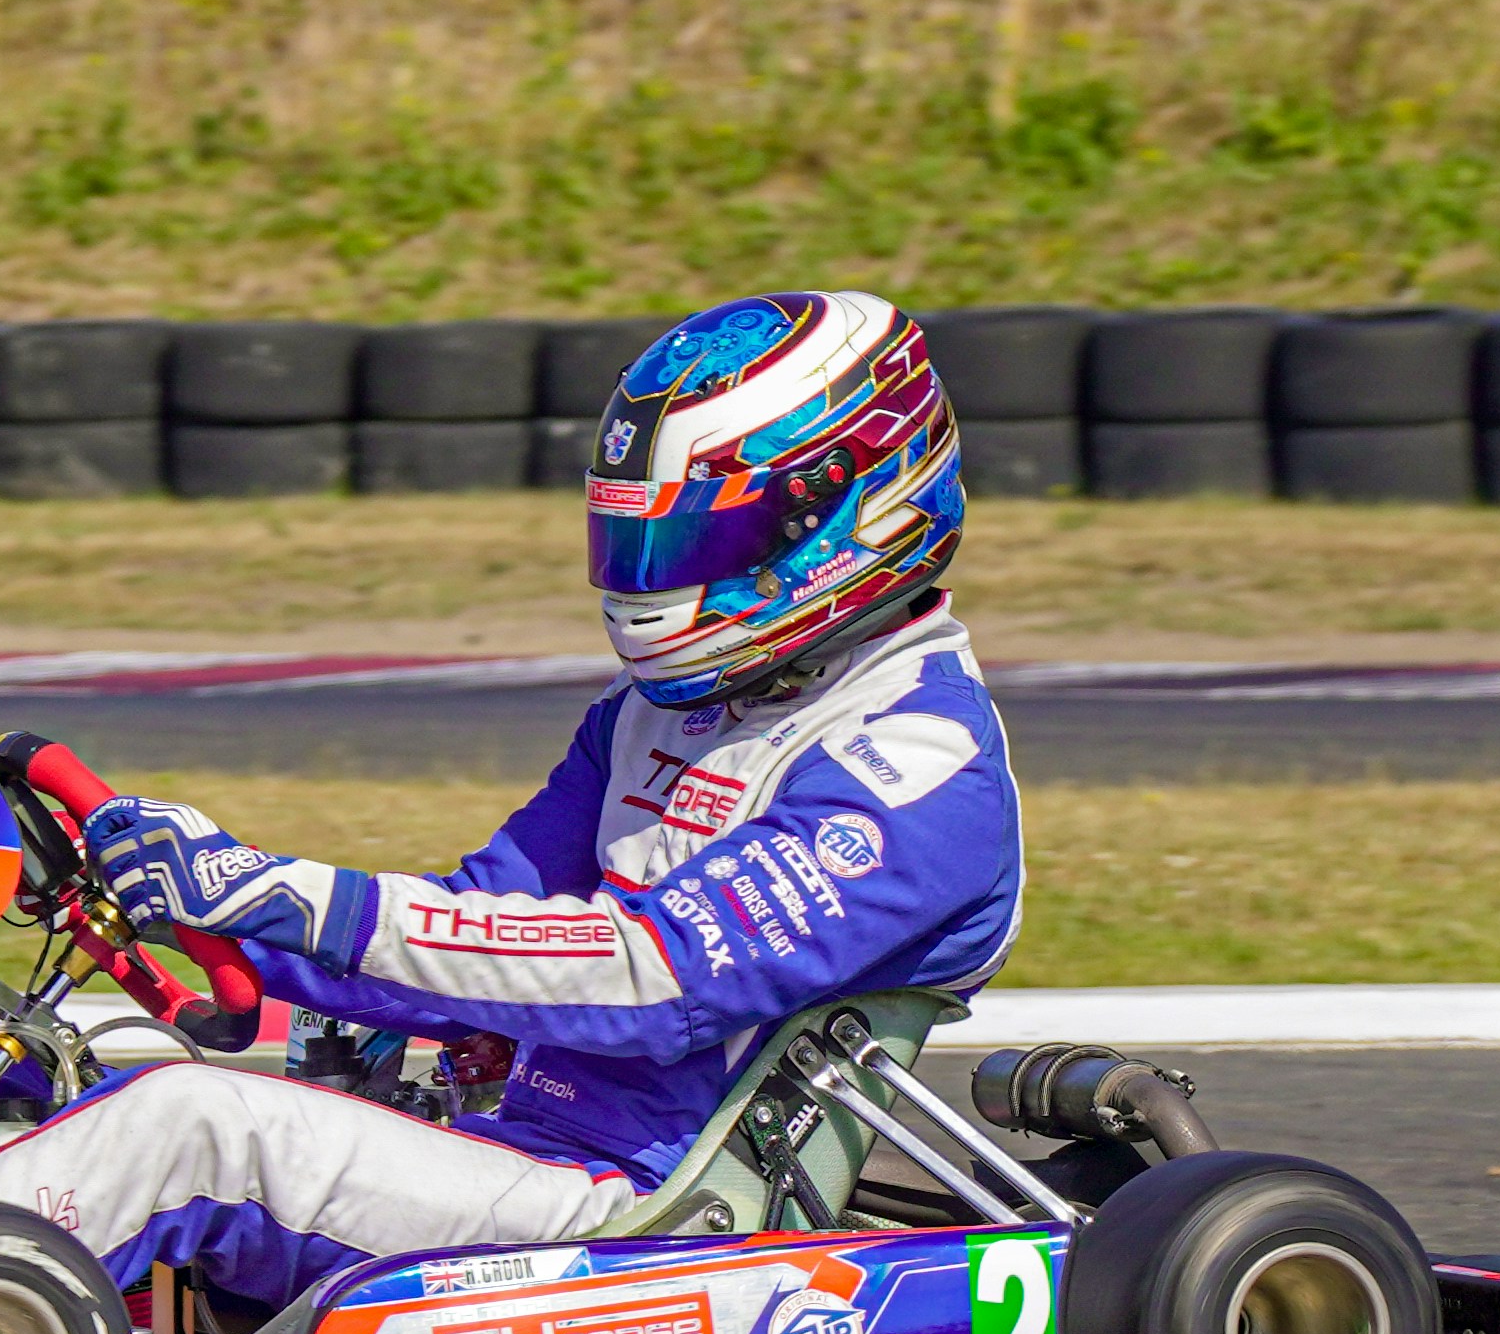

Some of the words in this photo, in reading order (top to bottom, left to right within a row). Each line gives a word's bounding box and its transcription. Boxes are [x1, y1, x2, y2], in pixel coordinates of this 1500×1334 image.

[792, 560, 856, 602] Halliday
[808, 550, 853, 581] Lewis
[844, 734, 902, 785] freem
[732, 875, 774, 924] CORSE
[760, 918, 796, 958] KART
[529, 1070, 577, 1098] Crook
